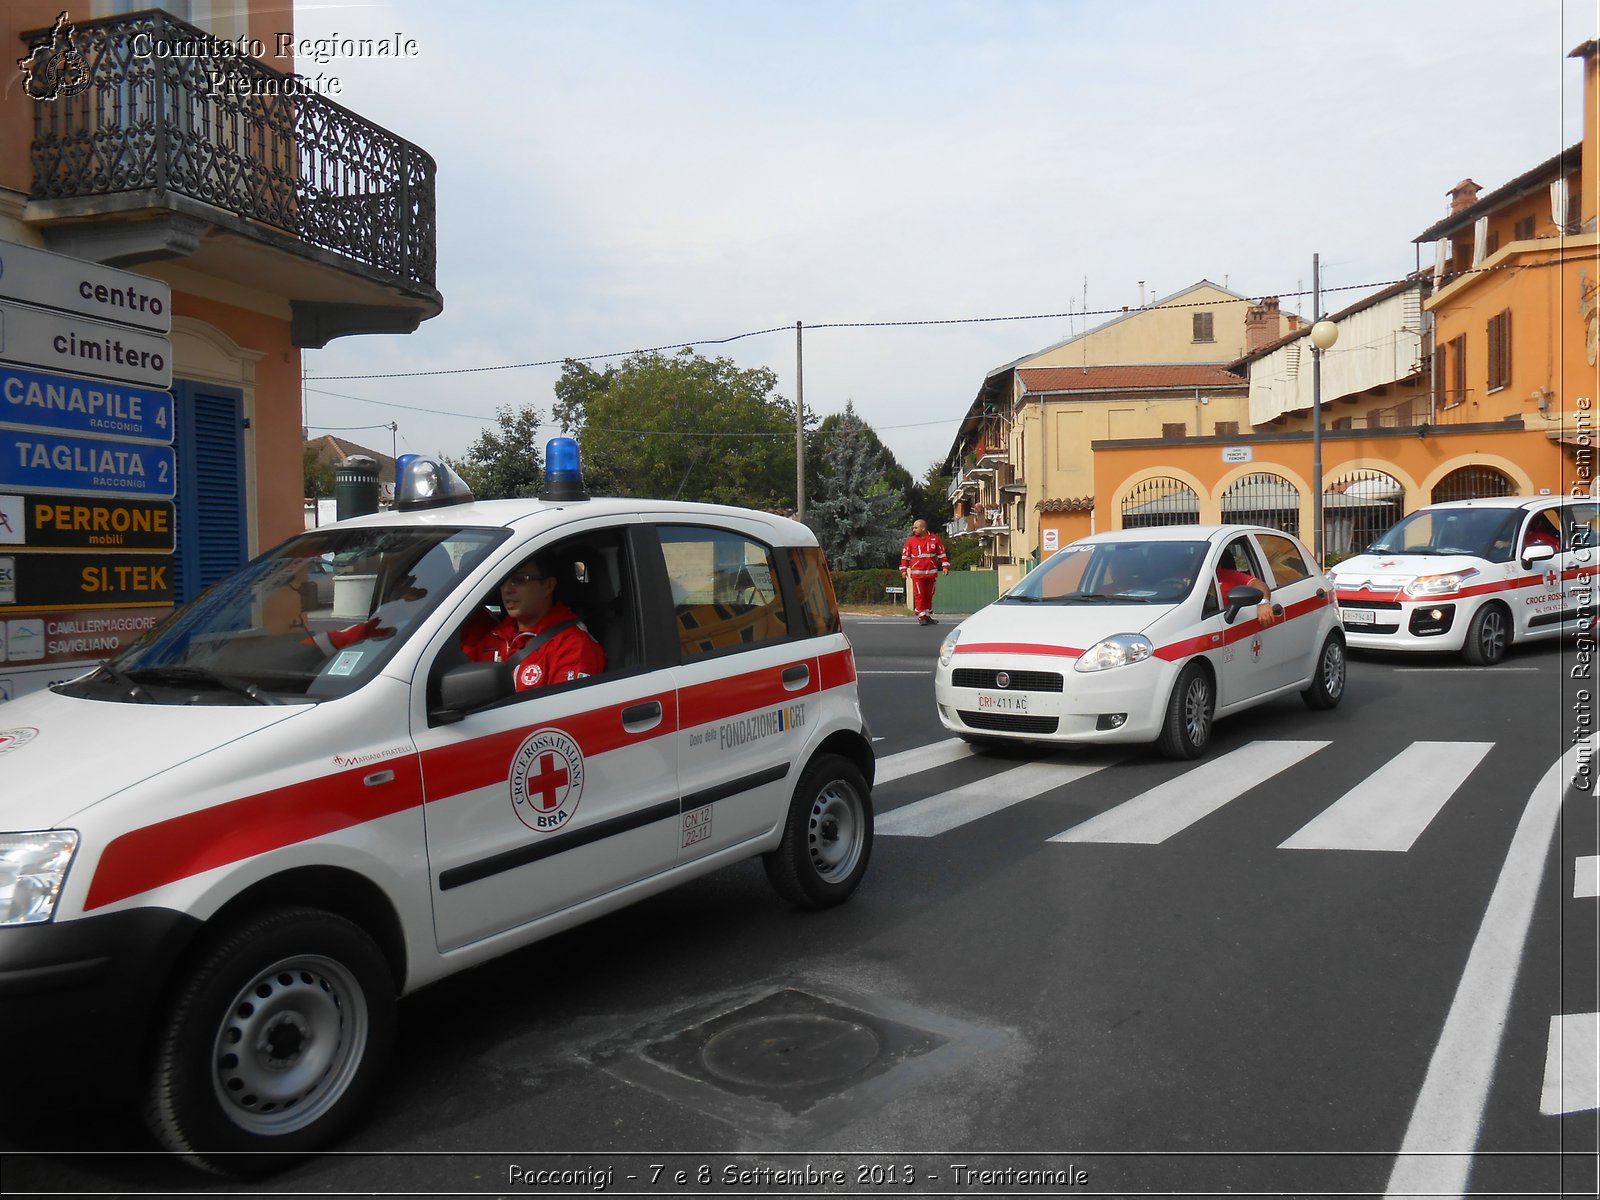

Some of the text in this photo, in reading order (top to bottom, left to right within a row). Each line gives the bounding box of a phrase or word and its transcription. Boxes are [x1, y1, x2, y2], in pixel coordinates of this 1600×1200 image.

[79, 281, 163, 315] centro
[53, 332, 164, 371] cimitero
[4, 378, 167, 429] CANAPILE 4
[90, 419, 142, 432] RACCONIGI
[15, 442, 168, 483] TAGLIATA 2
[93, 476, 145, 489] RACCONIGI
[35, 504, 168, 533] PERRONE
[89, 535, 124, 545] mobili
[81, 566, 167, 592] SI.TEK
[48, 636, 119, 655] SAVIGLIANO
[1016, 698, 1027, 710] AC
[720, 711, 778, 750] FONDAZIONE
[789, 703, 806, 729] CRT
[514, 736, 581, 805] CROCE ROSSA ITALIANA
[537, 809, 568, 828] BRA
[685, 807, 710, 828] CN 12
